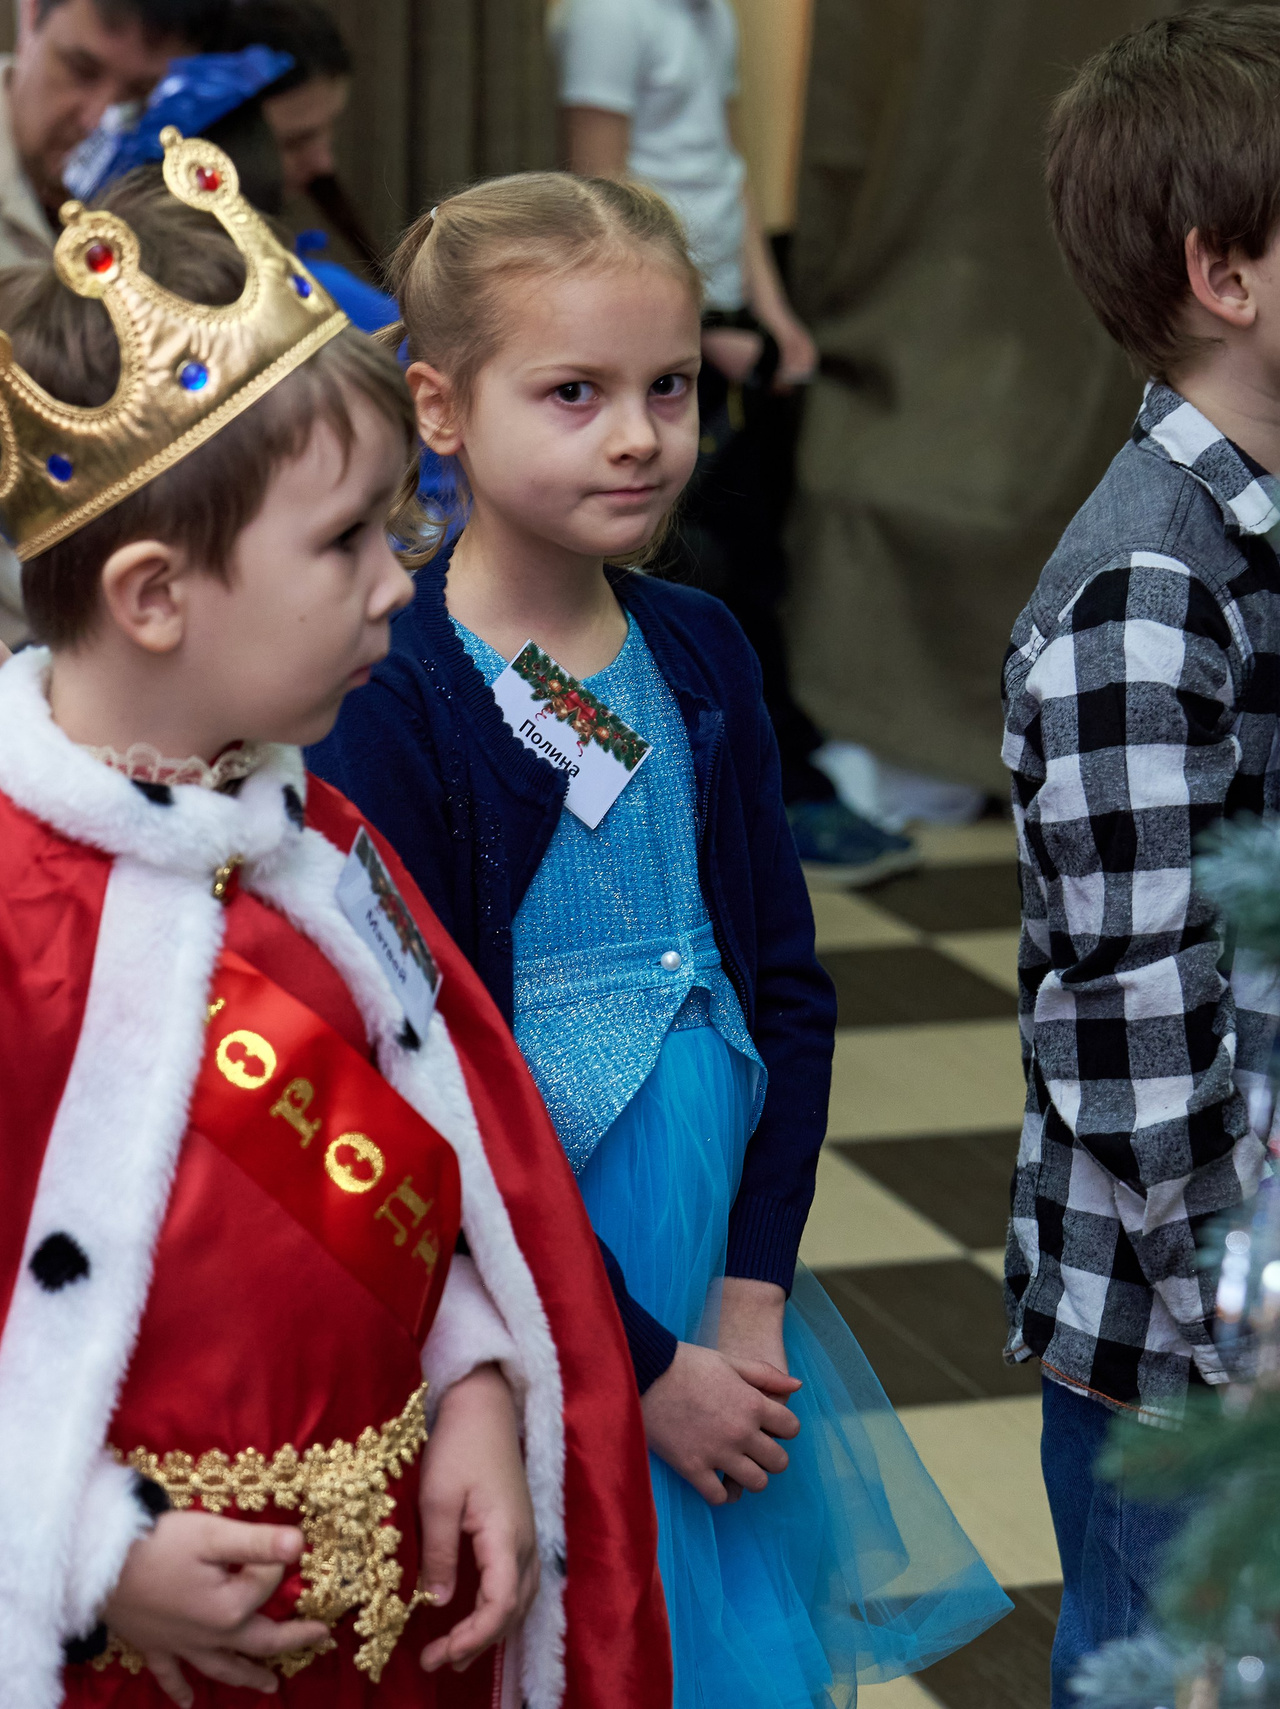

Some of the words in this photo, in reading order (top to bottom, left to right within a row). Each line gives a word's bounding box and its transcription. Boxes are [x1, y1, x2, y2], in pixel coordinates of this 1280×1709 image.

[518, 718, 581, 778] Полина
[365, 909, 408, 985] Матвей
[203, 997, 439, 1275] ОРОЛ
